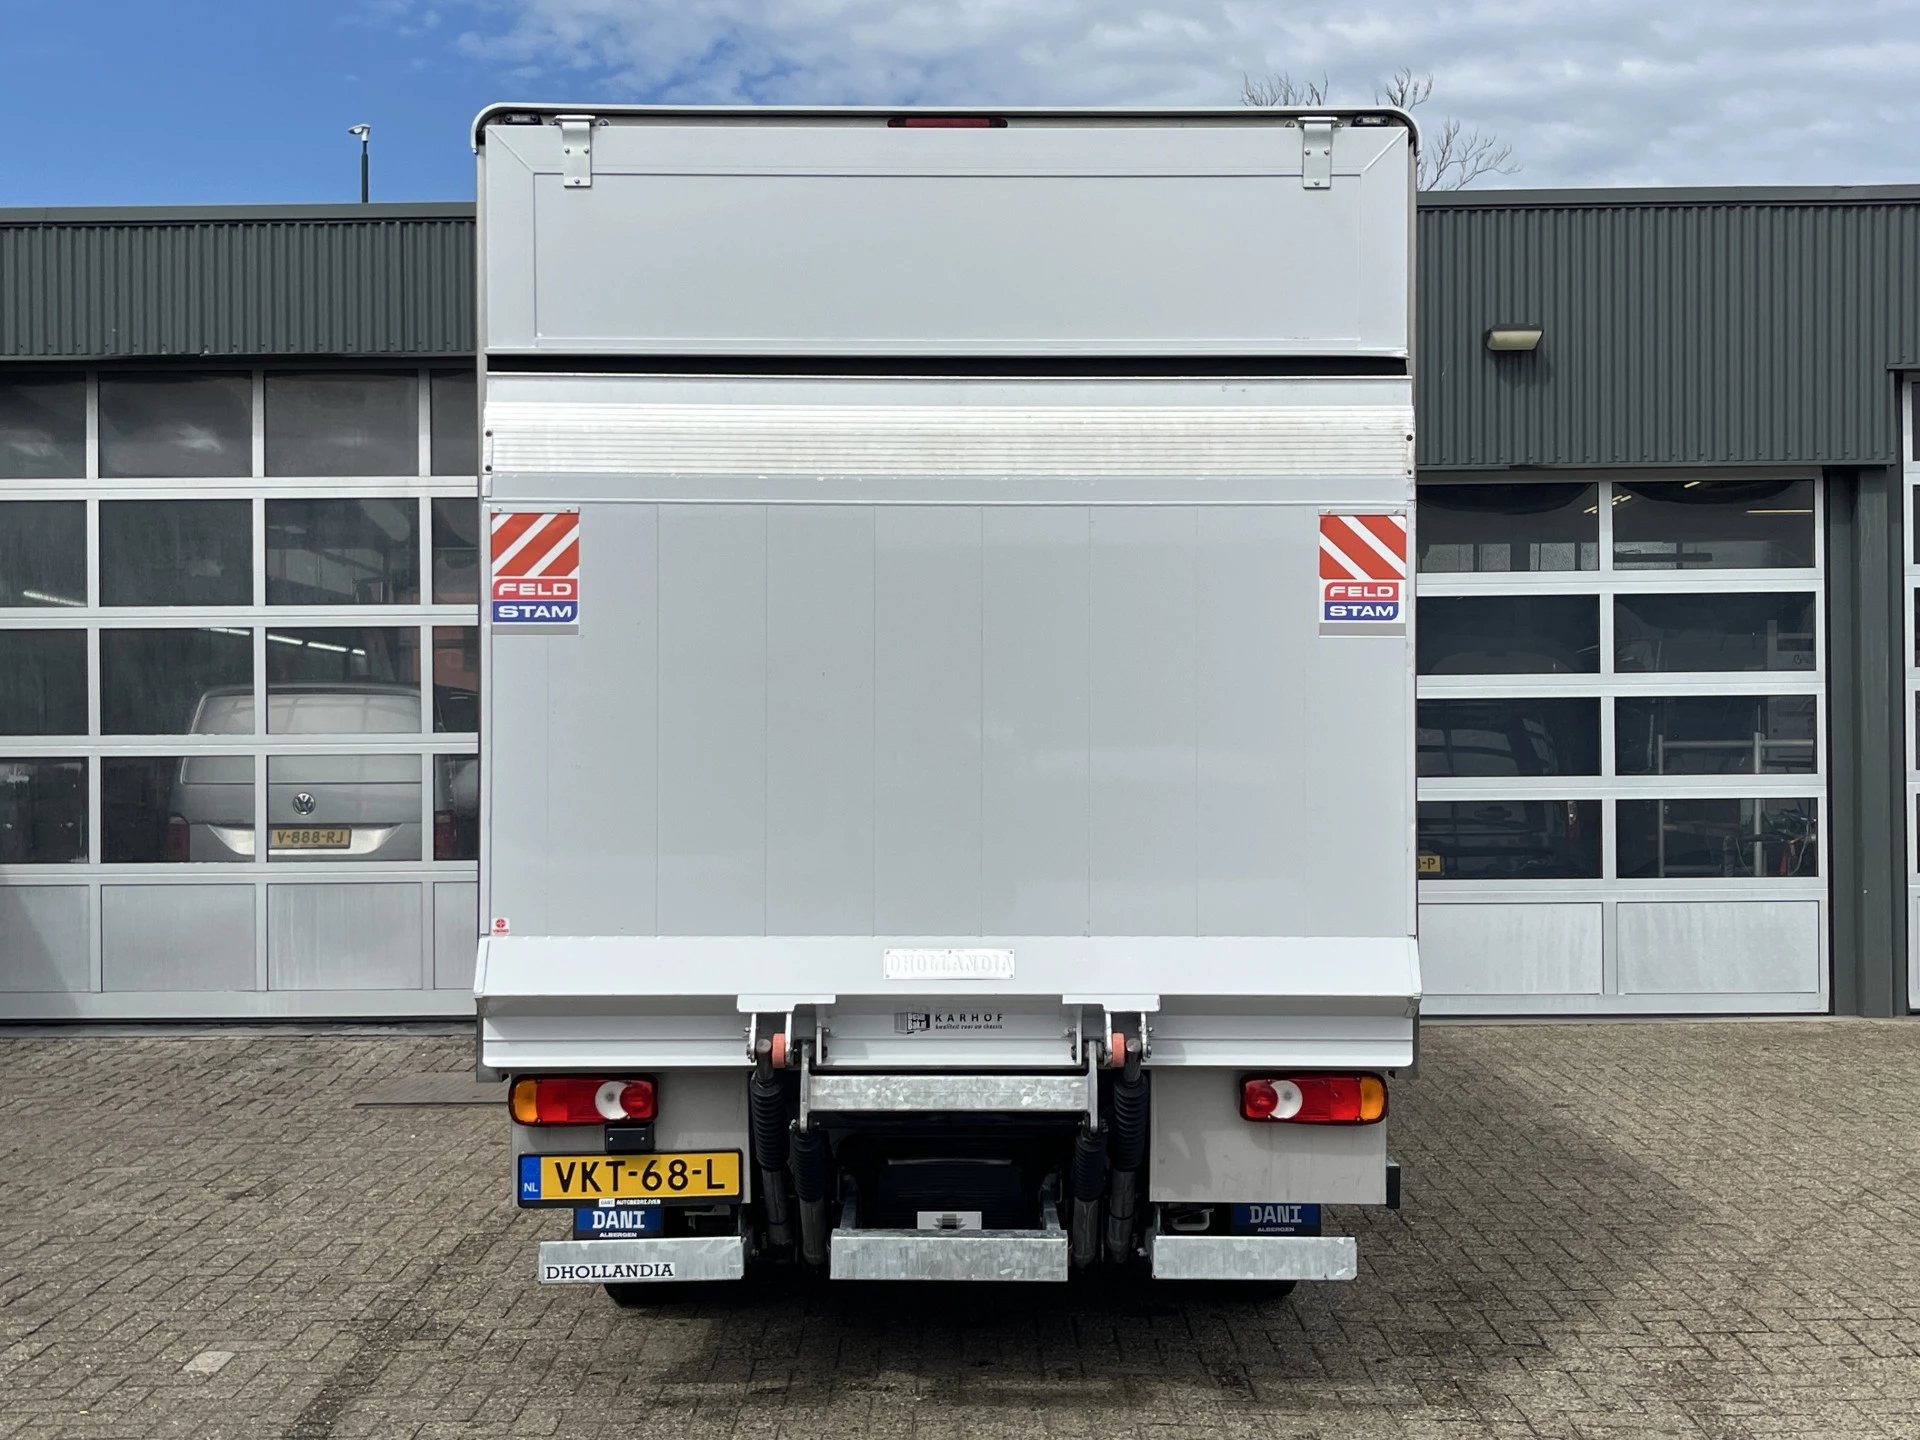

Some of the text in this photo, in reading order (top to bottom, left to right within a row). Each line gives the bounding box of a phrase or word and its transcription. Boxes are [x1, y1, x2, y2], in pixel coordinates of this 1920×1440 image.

[498, 583, 572, 596] FELD
[1329, 586, 1394, 597] FELD
[498, 605, 572, 618] STAM
[1329, 606, 1394, 617] STAM
[277, 831, 344, 844] V-888-RJ
[888, 954, 1013, 973] DHOLLANDIA
[935, 1013, 1003, 1022] KARHOF
[554, 1158, 725, 1193] VKT-68-L
[523, 1182, 539, 1193] NL
[592, 1210, 645, 1229] DANI
[1249, 1205, 1302, 1223] DANI
[546, 1263, 674, 1280] DHOLLANDIA
